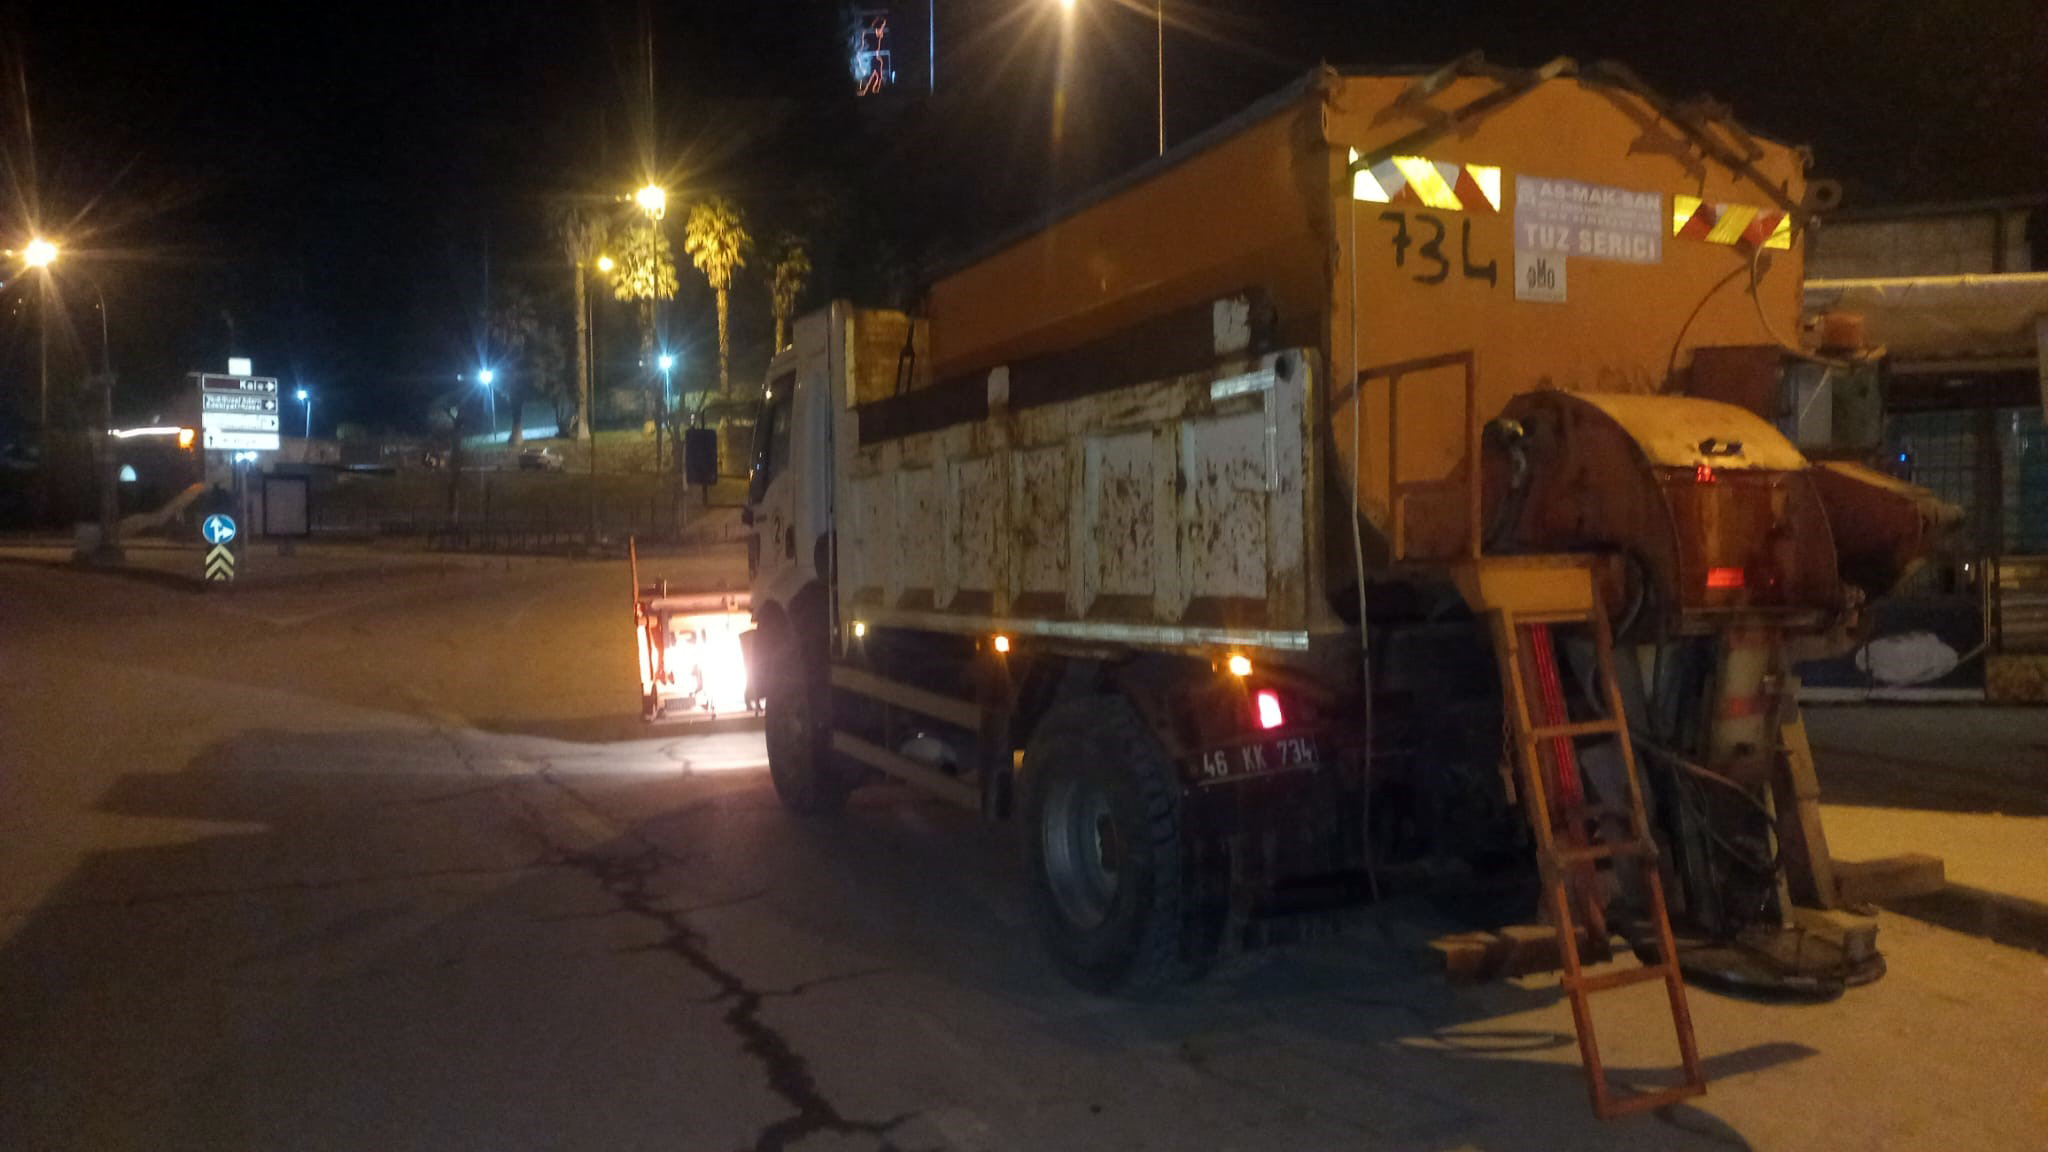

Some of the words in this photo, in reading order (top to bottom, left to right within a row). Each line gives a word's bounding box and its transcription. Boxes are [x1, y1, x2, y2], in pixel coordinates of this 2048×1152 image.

[1524, 224, 1570, 251] TUZ
[1203, 750, 1228, 777] 46
[1242, 743, 1267, 771] KK
[1277, 737, 1312, 766] 734
